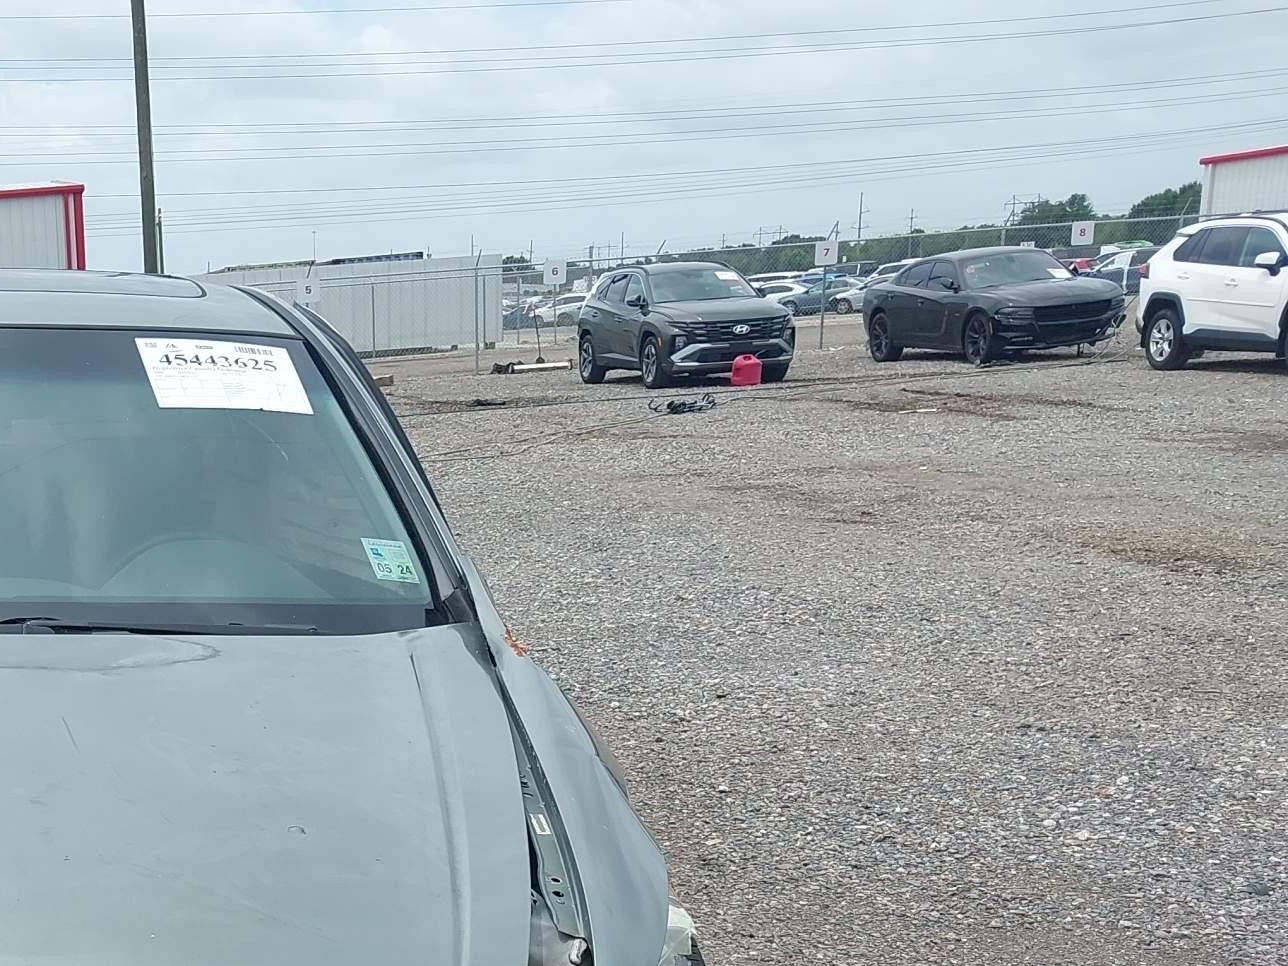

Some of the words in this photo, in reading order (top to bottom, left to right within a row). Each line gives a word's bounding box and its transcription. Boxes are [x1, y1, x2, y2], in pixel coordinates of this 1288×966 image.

[1079, 228, 1087, 237] 8
[823, 247, 831, 257] 7
[551, 267, 559, 276] 6
[305, 285, 312, 295] 5
[159, 353, 278, 373] 45443625
[376, 562, 392, 574] 05
[397, 564, 413, 576] 24
